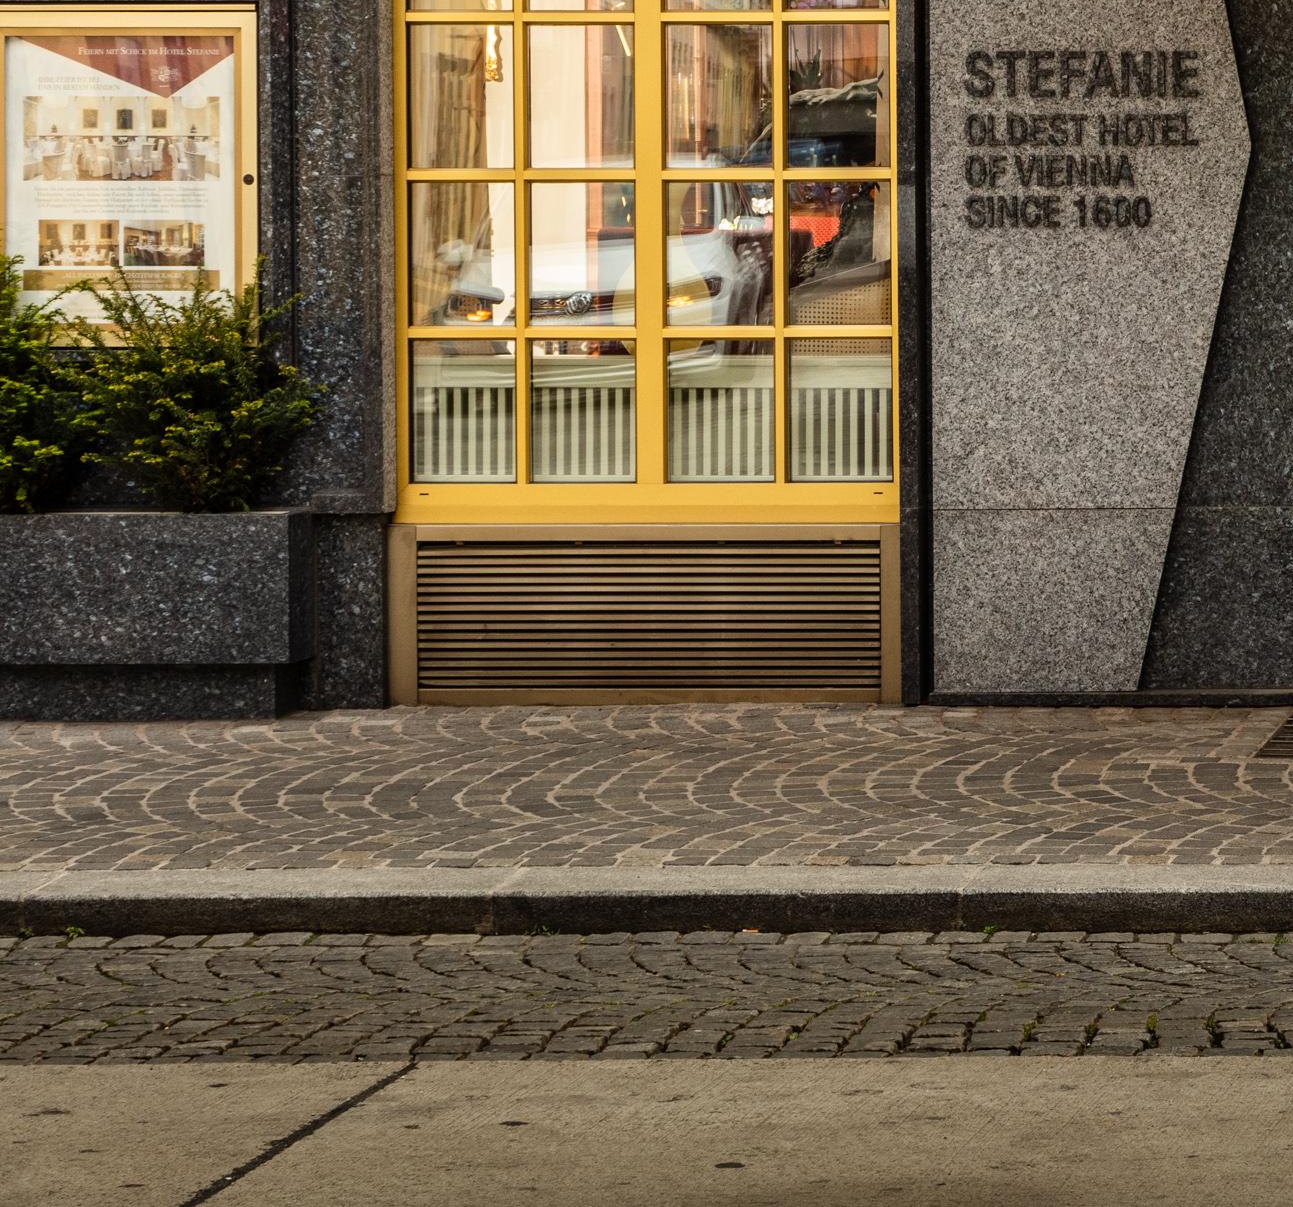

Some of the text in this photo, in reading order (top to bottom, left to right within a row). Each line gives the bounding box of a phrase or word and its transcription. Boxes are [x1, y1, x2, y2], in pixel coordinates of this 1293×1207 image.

[964, 50, 1201, 99] STEFANIE
[965, 113, 1199, 147] OLDEST HOTEL
[965, 154, 1135, 188] OF VIENNA
[965, 195, 1153, 230] SINCE 1600
